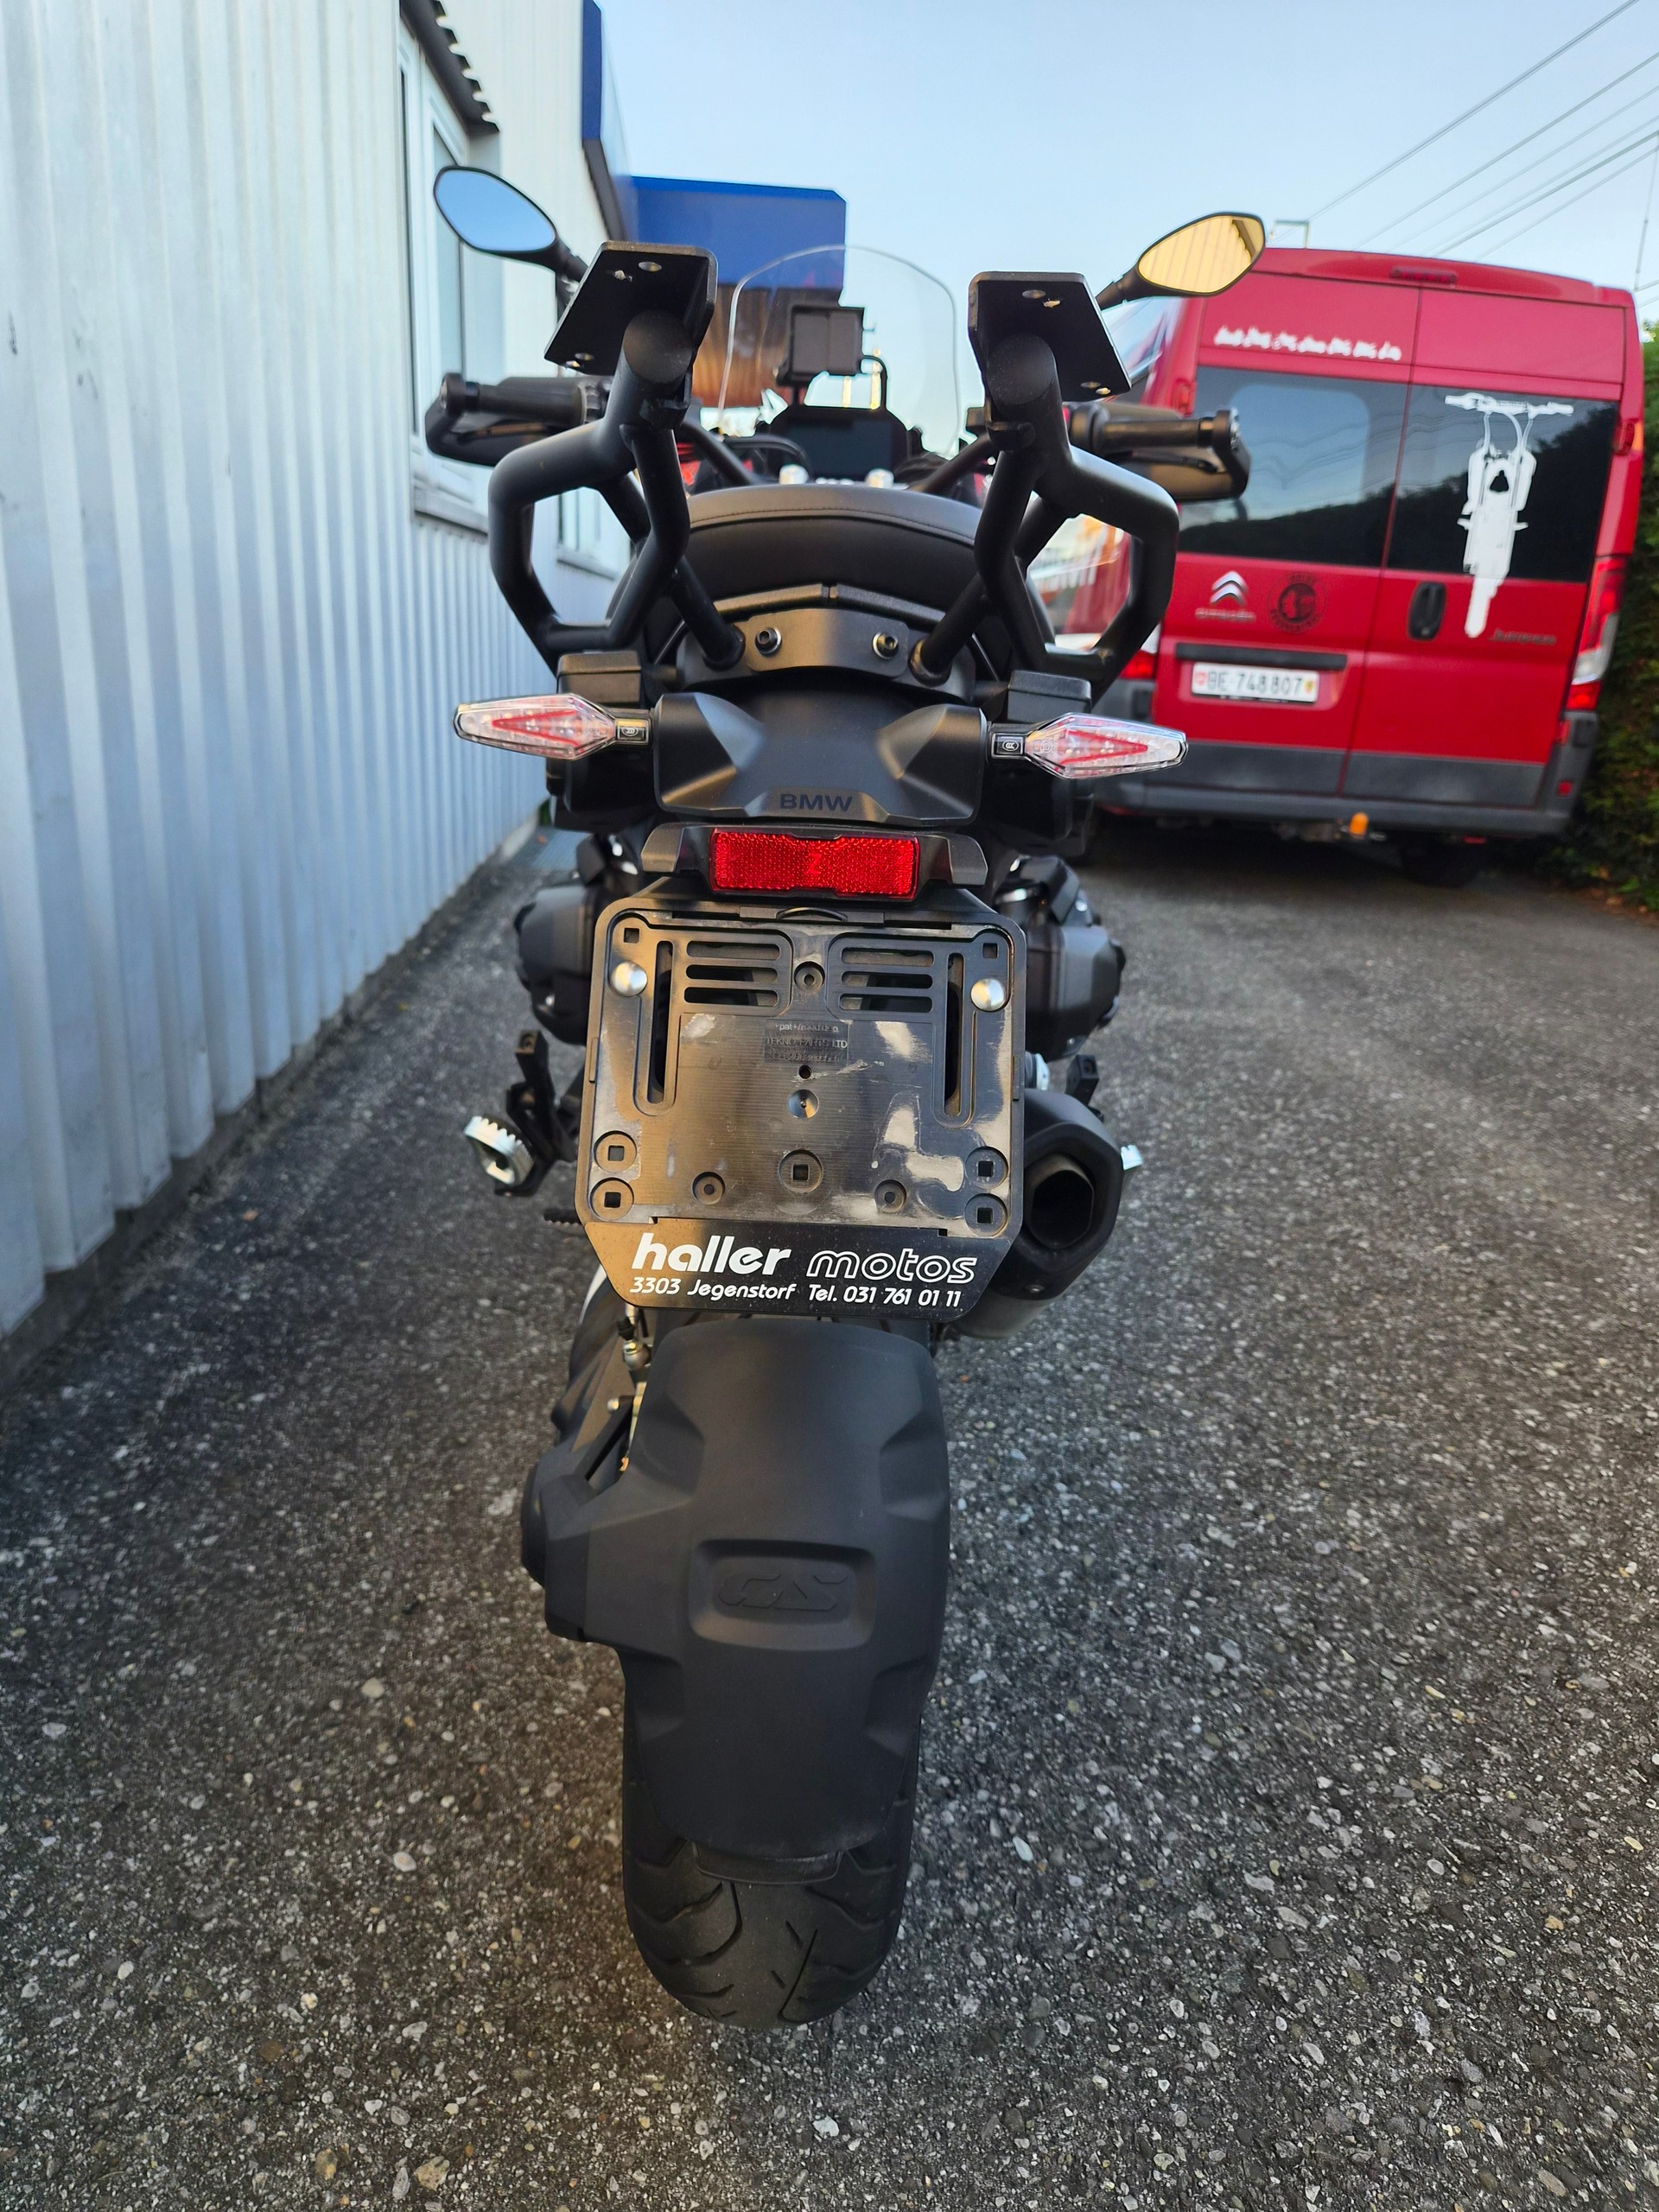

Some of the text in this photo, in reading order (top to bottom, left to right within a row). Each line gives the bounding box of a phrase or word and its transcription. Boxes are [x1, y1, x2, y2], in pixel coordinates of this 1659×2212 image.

[779, 793, 853, 812] BMW
[766, 1037, 848, 1049] TEKNO PARTS LTD
[631, 1232, 978, 1284] haller motos
[629, 1276, 962, 1307] 3303 Jegenstorf Tel. 031 761 01 11
